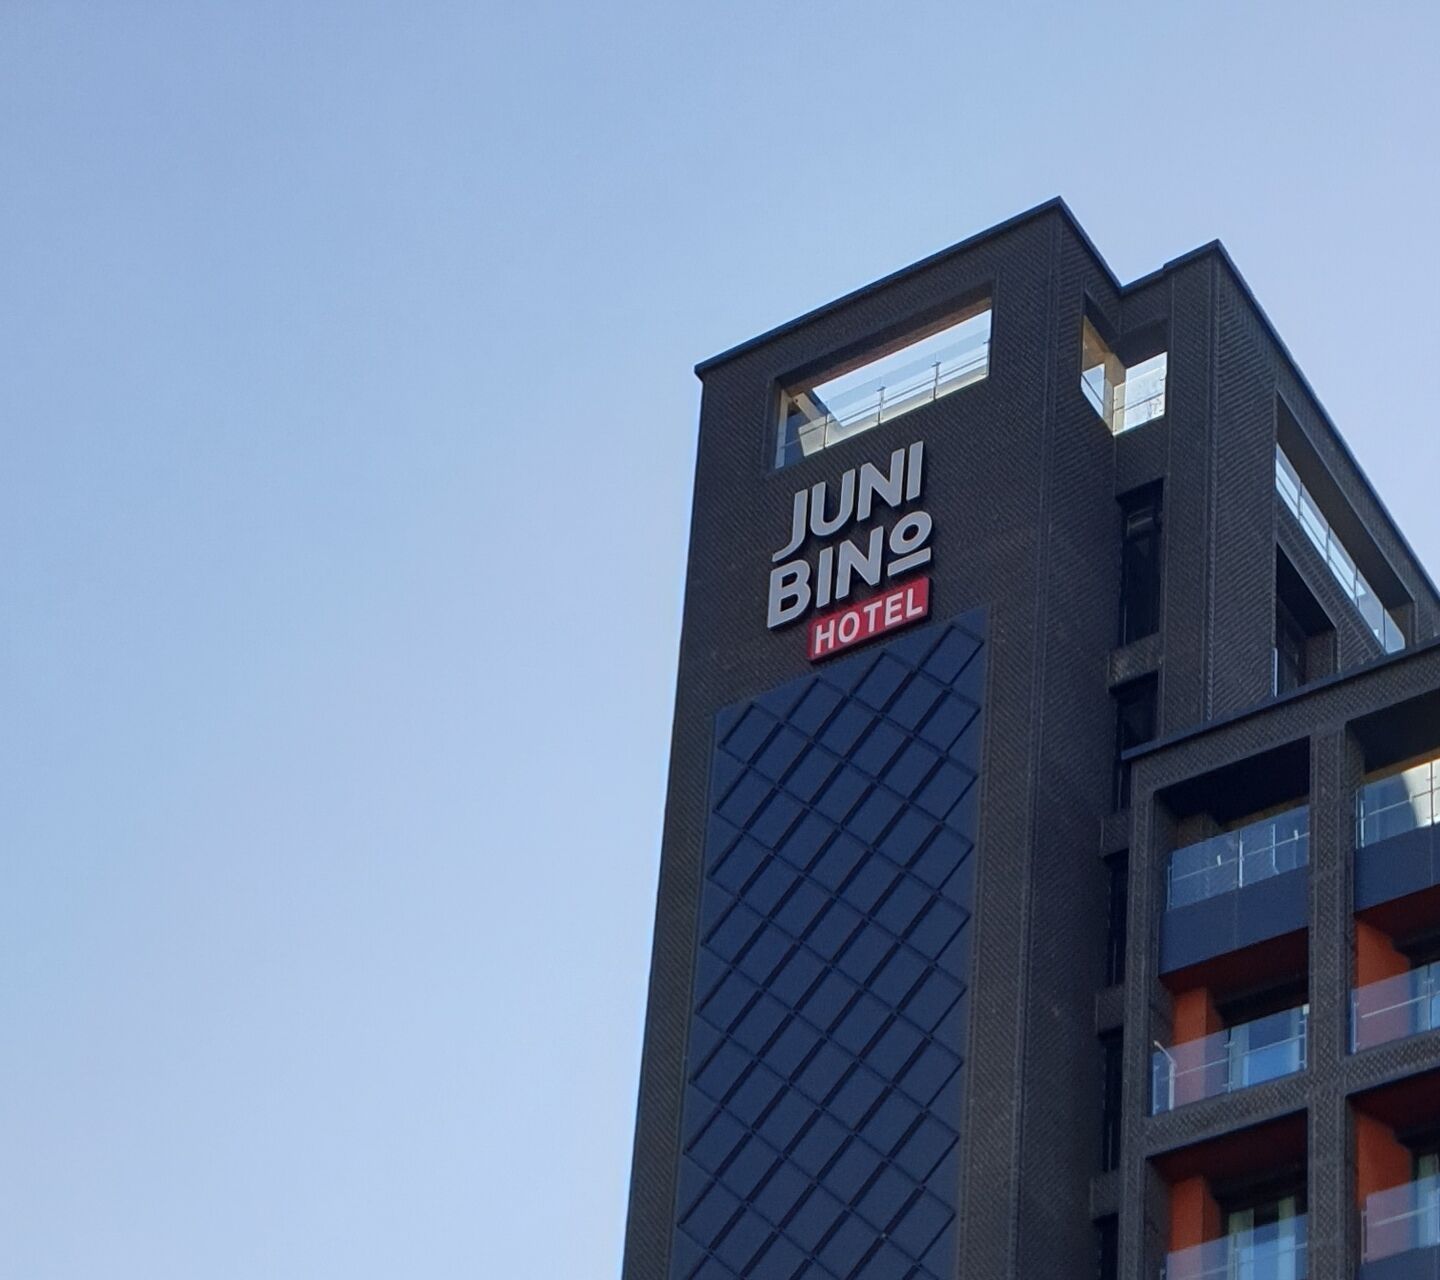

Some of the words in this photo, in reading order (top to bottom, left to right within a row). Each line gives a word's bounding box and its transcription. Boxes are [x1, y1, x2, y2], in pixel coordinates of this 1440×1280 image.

[771, 440, 924, 563] JUNI
[766, 510, 933, 629] BINO
[814, 588, 923, 654] HOTEL
